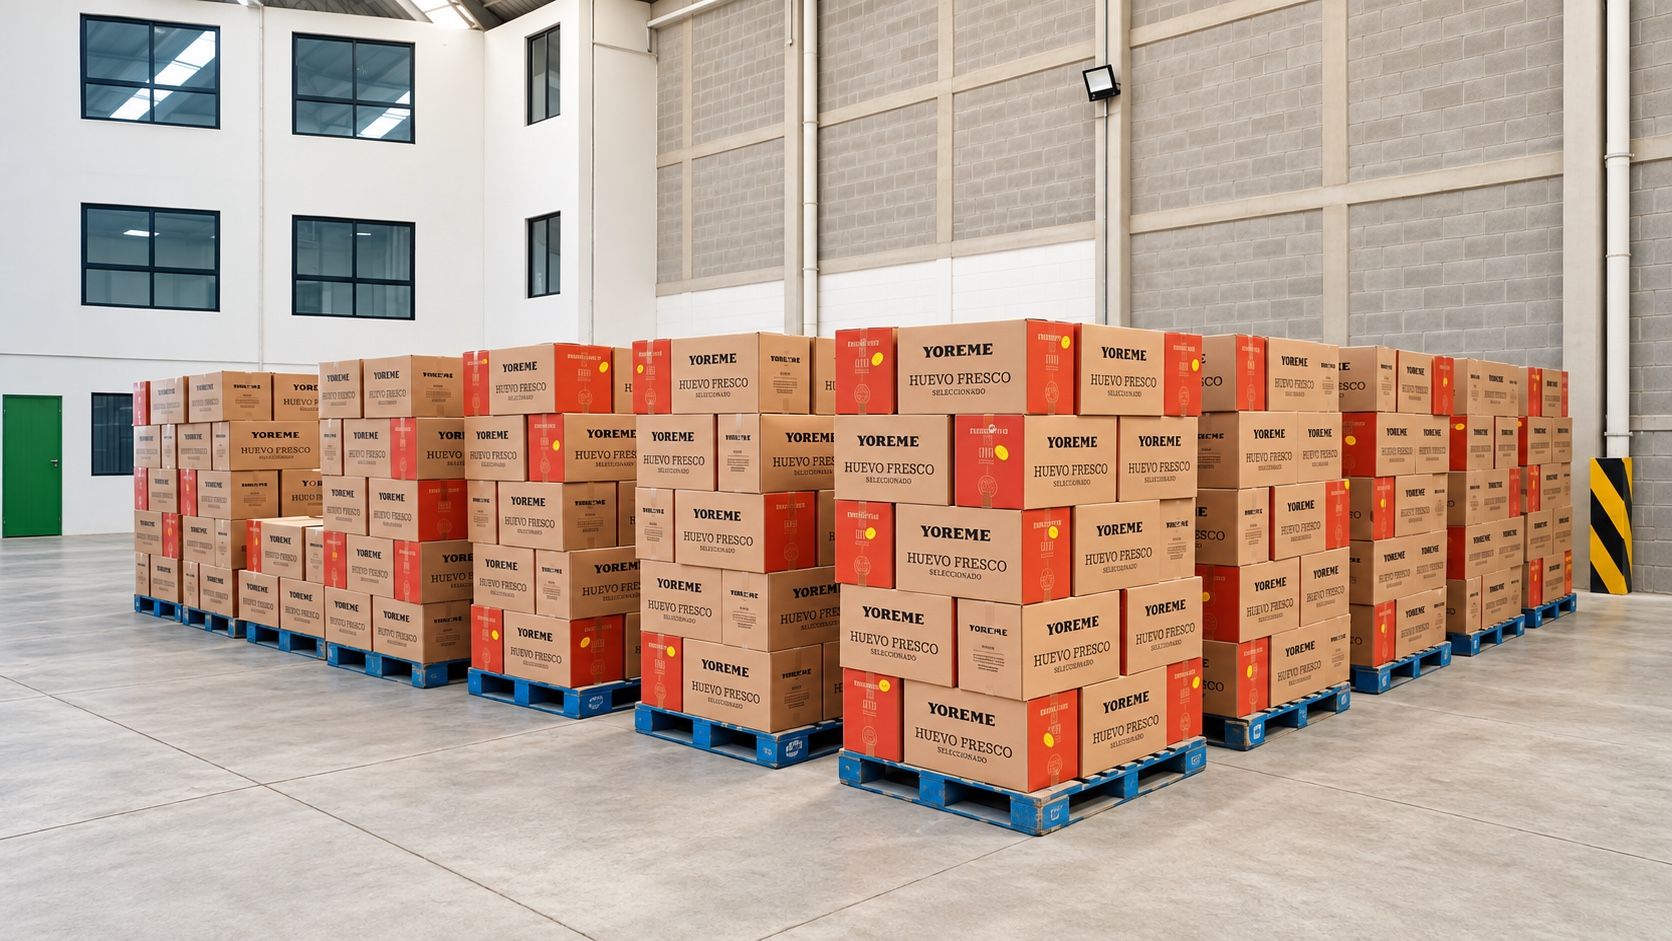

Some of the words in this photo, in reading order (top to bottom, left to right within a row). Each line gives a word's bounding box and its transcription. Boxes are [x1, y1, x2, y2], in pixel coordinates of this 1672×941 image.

[923, 343, 993, 358] YOREME
[1101, 346, 1147, 361] YOREME
[503, 361, 537, 372] YOREME
[689, 353, 737, 365] YOREME
[1281, 356, 1308, 367] YOREME
[679, 379, 710, 390] HUEVO
[712, 377, 748, 389] FRESCO
[909, 372, 954, 386] HUEVO
[957, 371, 1011, 385] FRESCO
[1090, 374, 1121, 387] HUEVO
[1123, 375, 1157, 389] FRESCO
[495, 384, 519, 394] HUEVO
[519, 382, 546, 392] FRESCO
[476, 430, 509, 439] YOREME
[652, 432, 694, 442] YOREME
[1254, 429, 1286, 439] YOREME
[1308, 428, 1333, 438] YOREME
[857, 435, 920, 448] YOREME
[1047, 436, 1098, 449] YOREME
[1138, 436, 1182, 447] YOREME
[275, 446, 311, 454] FRESCO
[427, 451, 462, 459] HUEVO
[470, 451, 490, 460] HUEVO
[492, 451, 517, 460] FRESCO
[575, 450, 611, 460] HUEVO
[643, 455, 670, 465] HUEVO
[672, 455, 705, 466] FRESCO
[773, 456, 810, 467] HUEVO
[1128, 462, 1158, 474] HUEVO
[1160, 460, 1191, 473] FRESCO
[844, 461, 884, 475] HUEVO
[887, 462, 935, 476] FRESCO
[1034, 464, 1070, 478] HUEVO
[1072, 462, 1108, 476] FRESCO
[511, 496, 546, 507] YOREME
[1287, 500, 1315, 512] YOREME
[504, 516, 527, 526] HUEVO
[528, 517, 555, 528] FRESCO
[693, 508, 741, 522] YOREME
[920, 524, 991, 542] YOREME
[1096, 521, 1143, 537] YOREME
[683, 531, 714, 543] HUEVO
[716, 533, 753, 546] FRESCO
[442, 553, 473, 563] YORE
[907, 551, 951, 567] HUEVO
[954, 556, 1008, 573] FRESCO
[1085, 550, 1117, 566] HUEVO
[1119, 546, 1153, 562] FRESCO
[485, 559, 518, 571] YOREME
[1313, 565, 1339, 579] YOREME
[431, 573, 467, 583] HUEVO
[479, 577, 500, 588] HUEVO
[501, 581, 527, 593] FRESCO
[657, 578, 702, 593] YOREME
[1254, 576, 1287, 592] YOREME
[582, 584, 618, 596] HUEVO
[648, 600, 676, 613] HUEVO
[678, 604, 712, 618] FRESCO
[862, 605, 925, 625] YOREME
[1145, 599, 1186, 617] YOREME
[383, 610, 410, 623] YOREME
[781, 610, 816, 625] HUEVO
[1046, 615, 1099, 636] YOREME
[517, 627, 553, 642] YOREME
[850, 630, 890, 646] HUEVO
[1135, 629, 1165, 645] HUEVO
[1167, 622, 1195, 639] FRESCO
[510, 646, 533, 659] HUEVO
[534, 651, 562, 665] FRESCO
[1034, 649, 1070, 667] HUEVO
[1073, 641, 1111, 659] FRESCO
[1285, 640, 1316, 657] YOREME
[701, 659, 749, 678] YOREME
[692, 680, 722, 696] HUEVO
[724, 687, 760, 704] FRESCO
[1103, 690, 1150, 714] YOREME
[927, 701, 995, 726] YOREME
[915, 727, 957, 747] HUEVO
[1093, 724, 1124, 744] HUEVO
